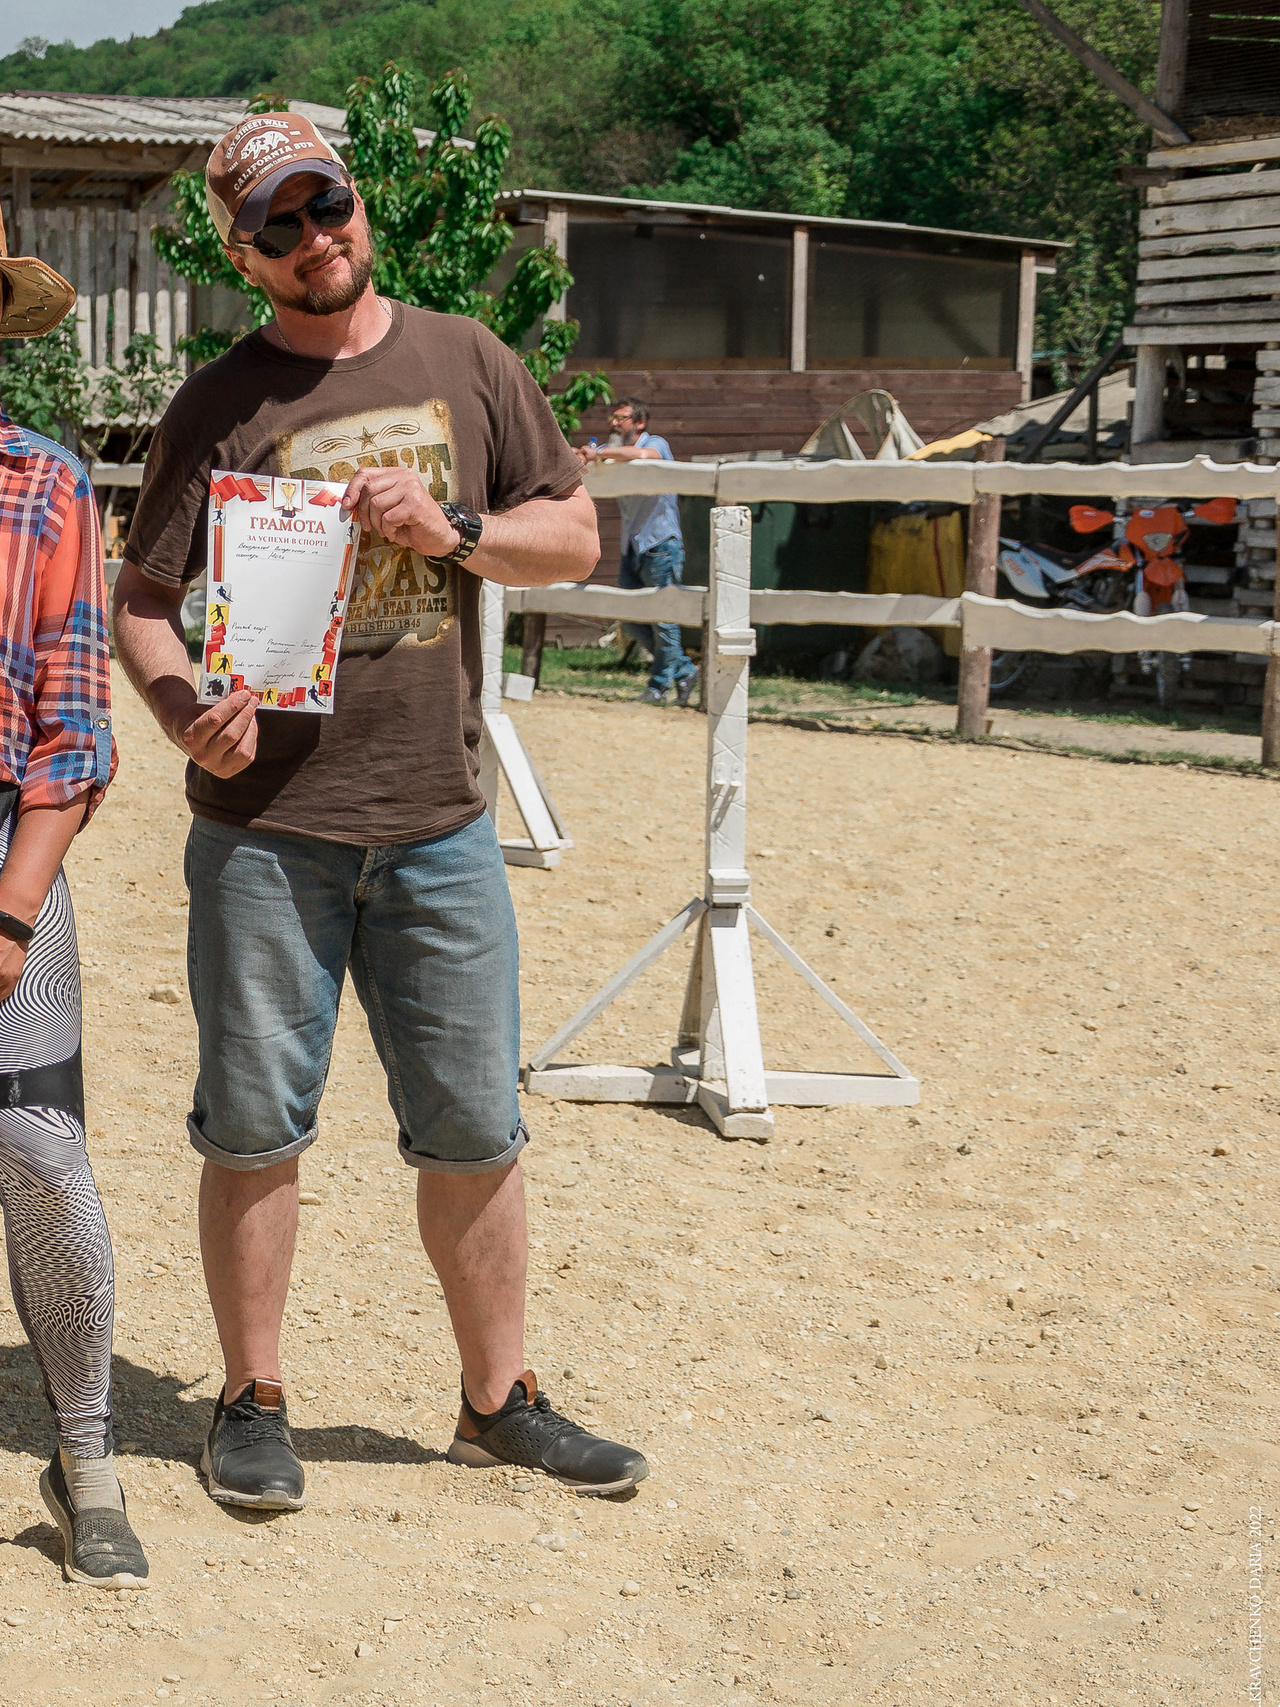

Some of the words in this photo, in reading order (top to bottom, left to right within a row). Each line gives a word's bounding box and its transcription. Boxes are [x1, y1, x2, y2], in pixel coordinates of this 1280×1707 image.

[235, 119, 263, 140] STREET
[233, 145, 293, 191] CALIFORNIA
[294, 141, 315, 150] SUN
[250, 516, 326, 535] ГРАМОТА
[258, 536, 289, 544] УСПЕХИ
[298, 538, 329, 547] СПОРТЕ
[383, 600, 412, 616] STAR
[417, 597, 448, 613] STATE
[399, 618, 421, 629] 1845
